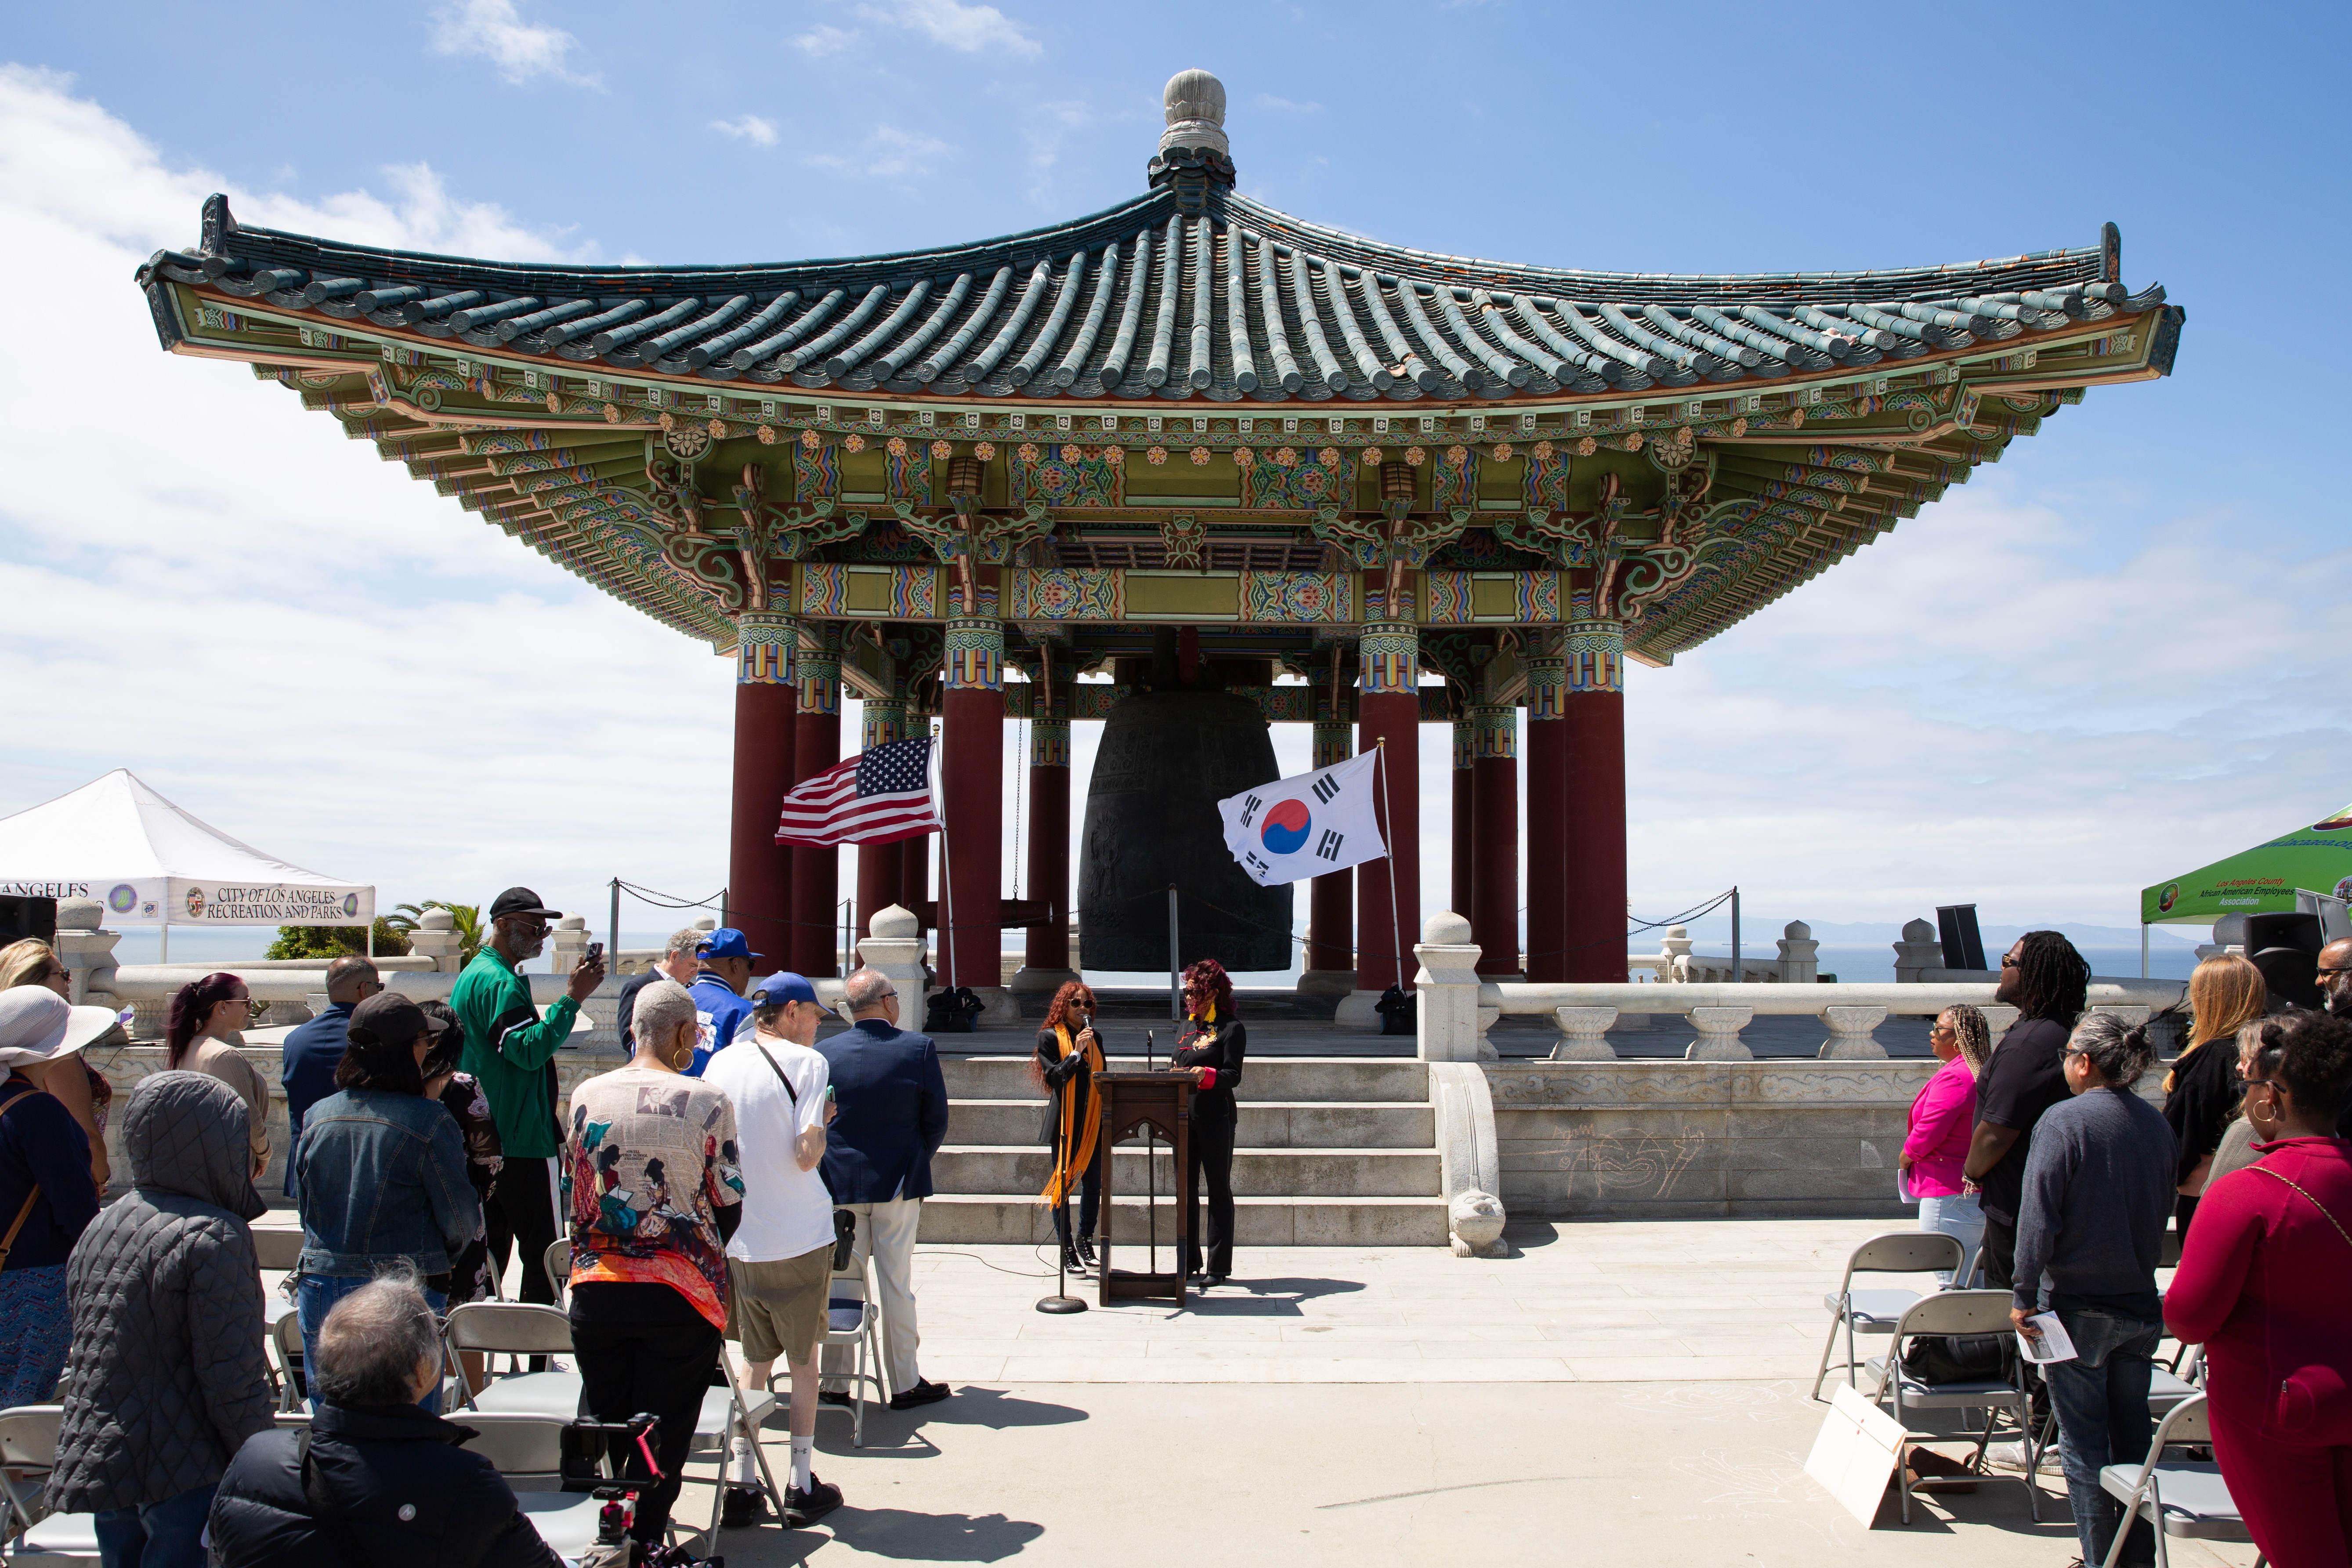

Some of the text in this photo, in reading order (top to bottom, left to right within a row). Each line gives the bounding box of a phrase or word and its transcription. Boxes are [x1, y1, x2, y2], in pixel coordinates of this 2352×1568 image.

[2229, 878, 2257, 887] Angeles
[2258, 877, 2286, 886] County
[218, 888, 336, 904] CITY OF LOS ANGELES
[2199, 886, 2296, 898] African American Employees
[2218, 897, 2260, 906] Association
[207, 904, 343, 919] RECREATION AND PARKS
